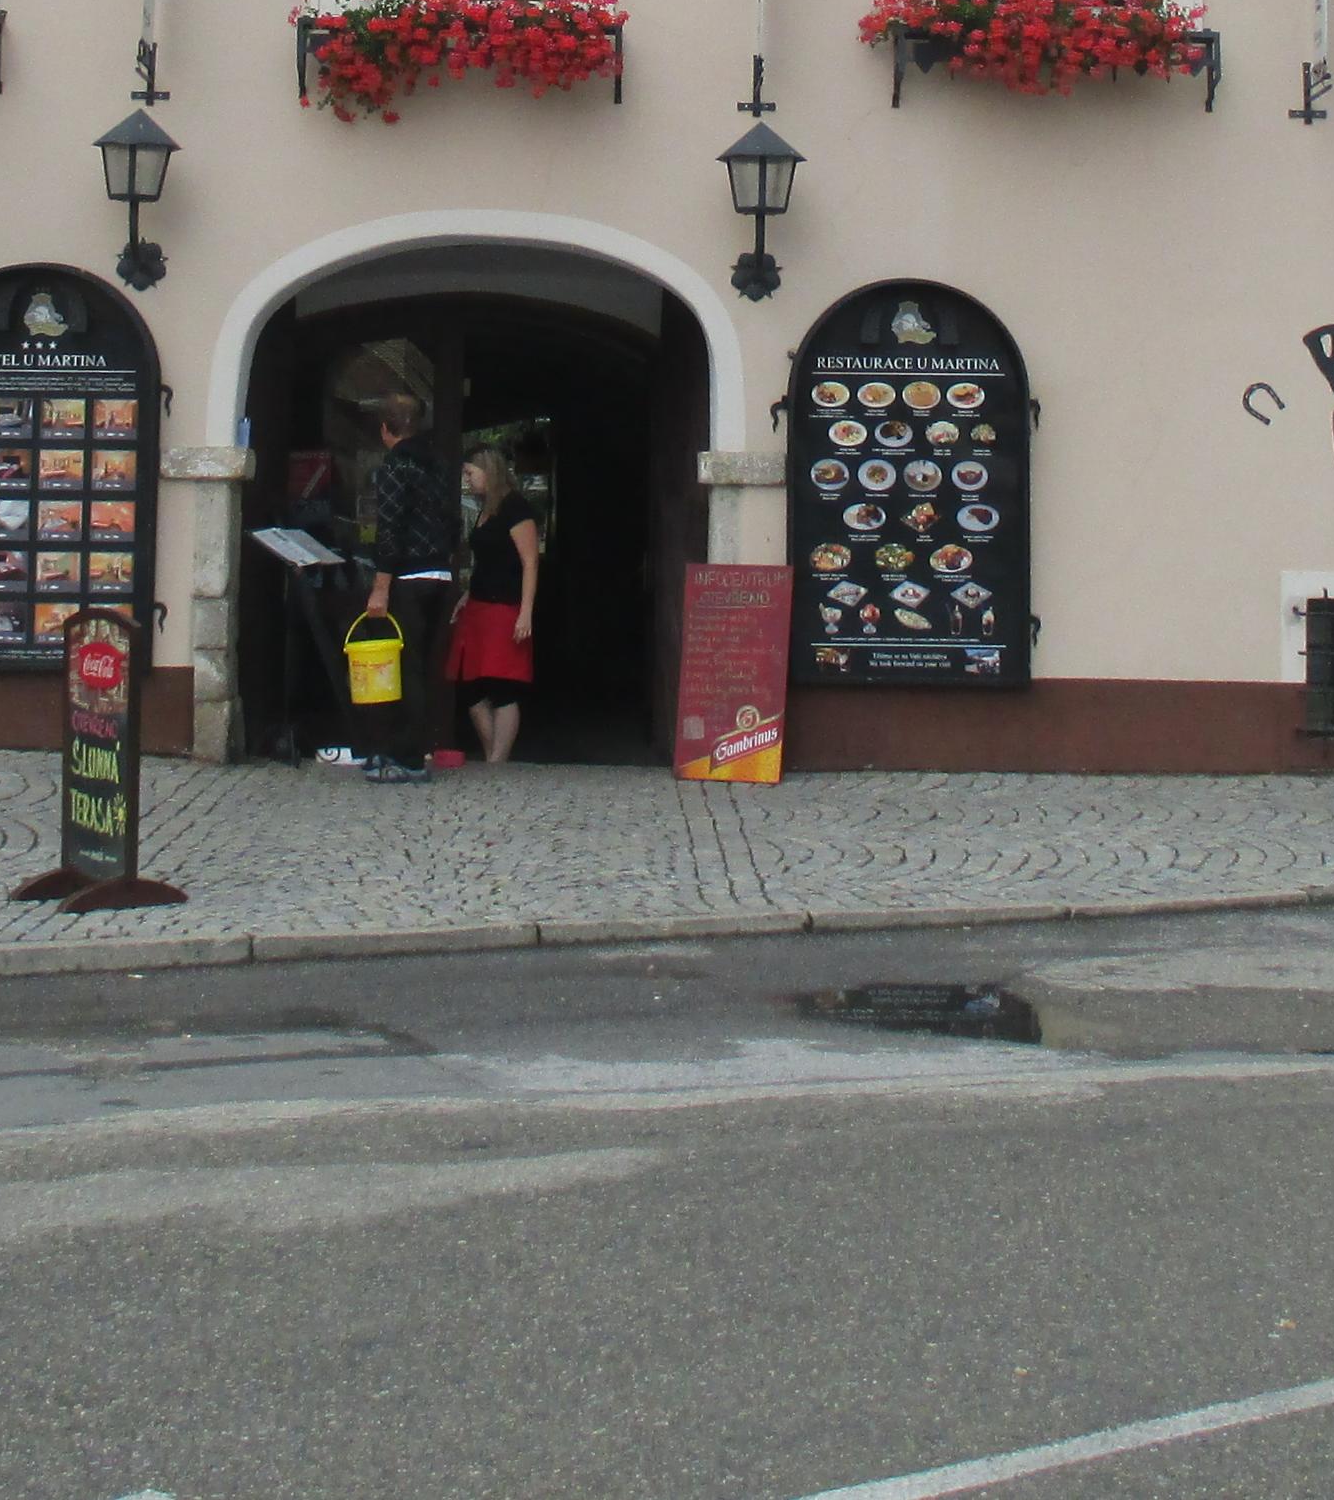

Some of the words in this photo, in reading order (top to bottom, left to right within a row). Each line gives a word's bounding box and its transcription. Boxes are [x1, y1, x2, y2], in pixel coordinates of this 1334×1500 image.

[23, 354, 35, 367] U
[37, 354, 107, 368] MARTINA
[816, 356, 914, 370] RESTAURACE
[917, 357, 928, 370] U
[931, 357, 1000, 371] MARTINA
[713, 726, 778, 761] Gambrinus
[69, 787, 114, 838] TERASA
